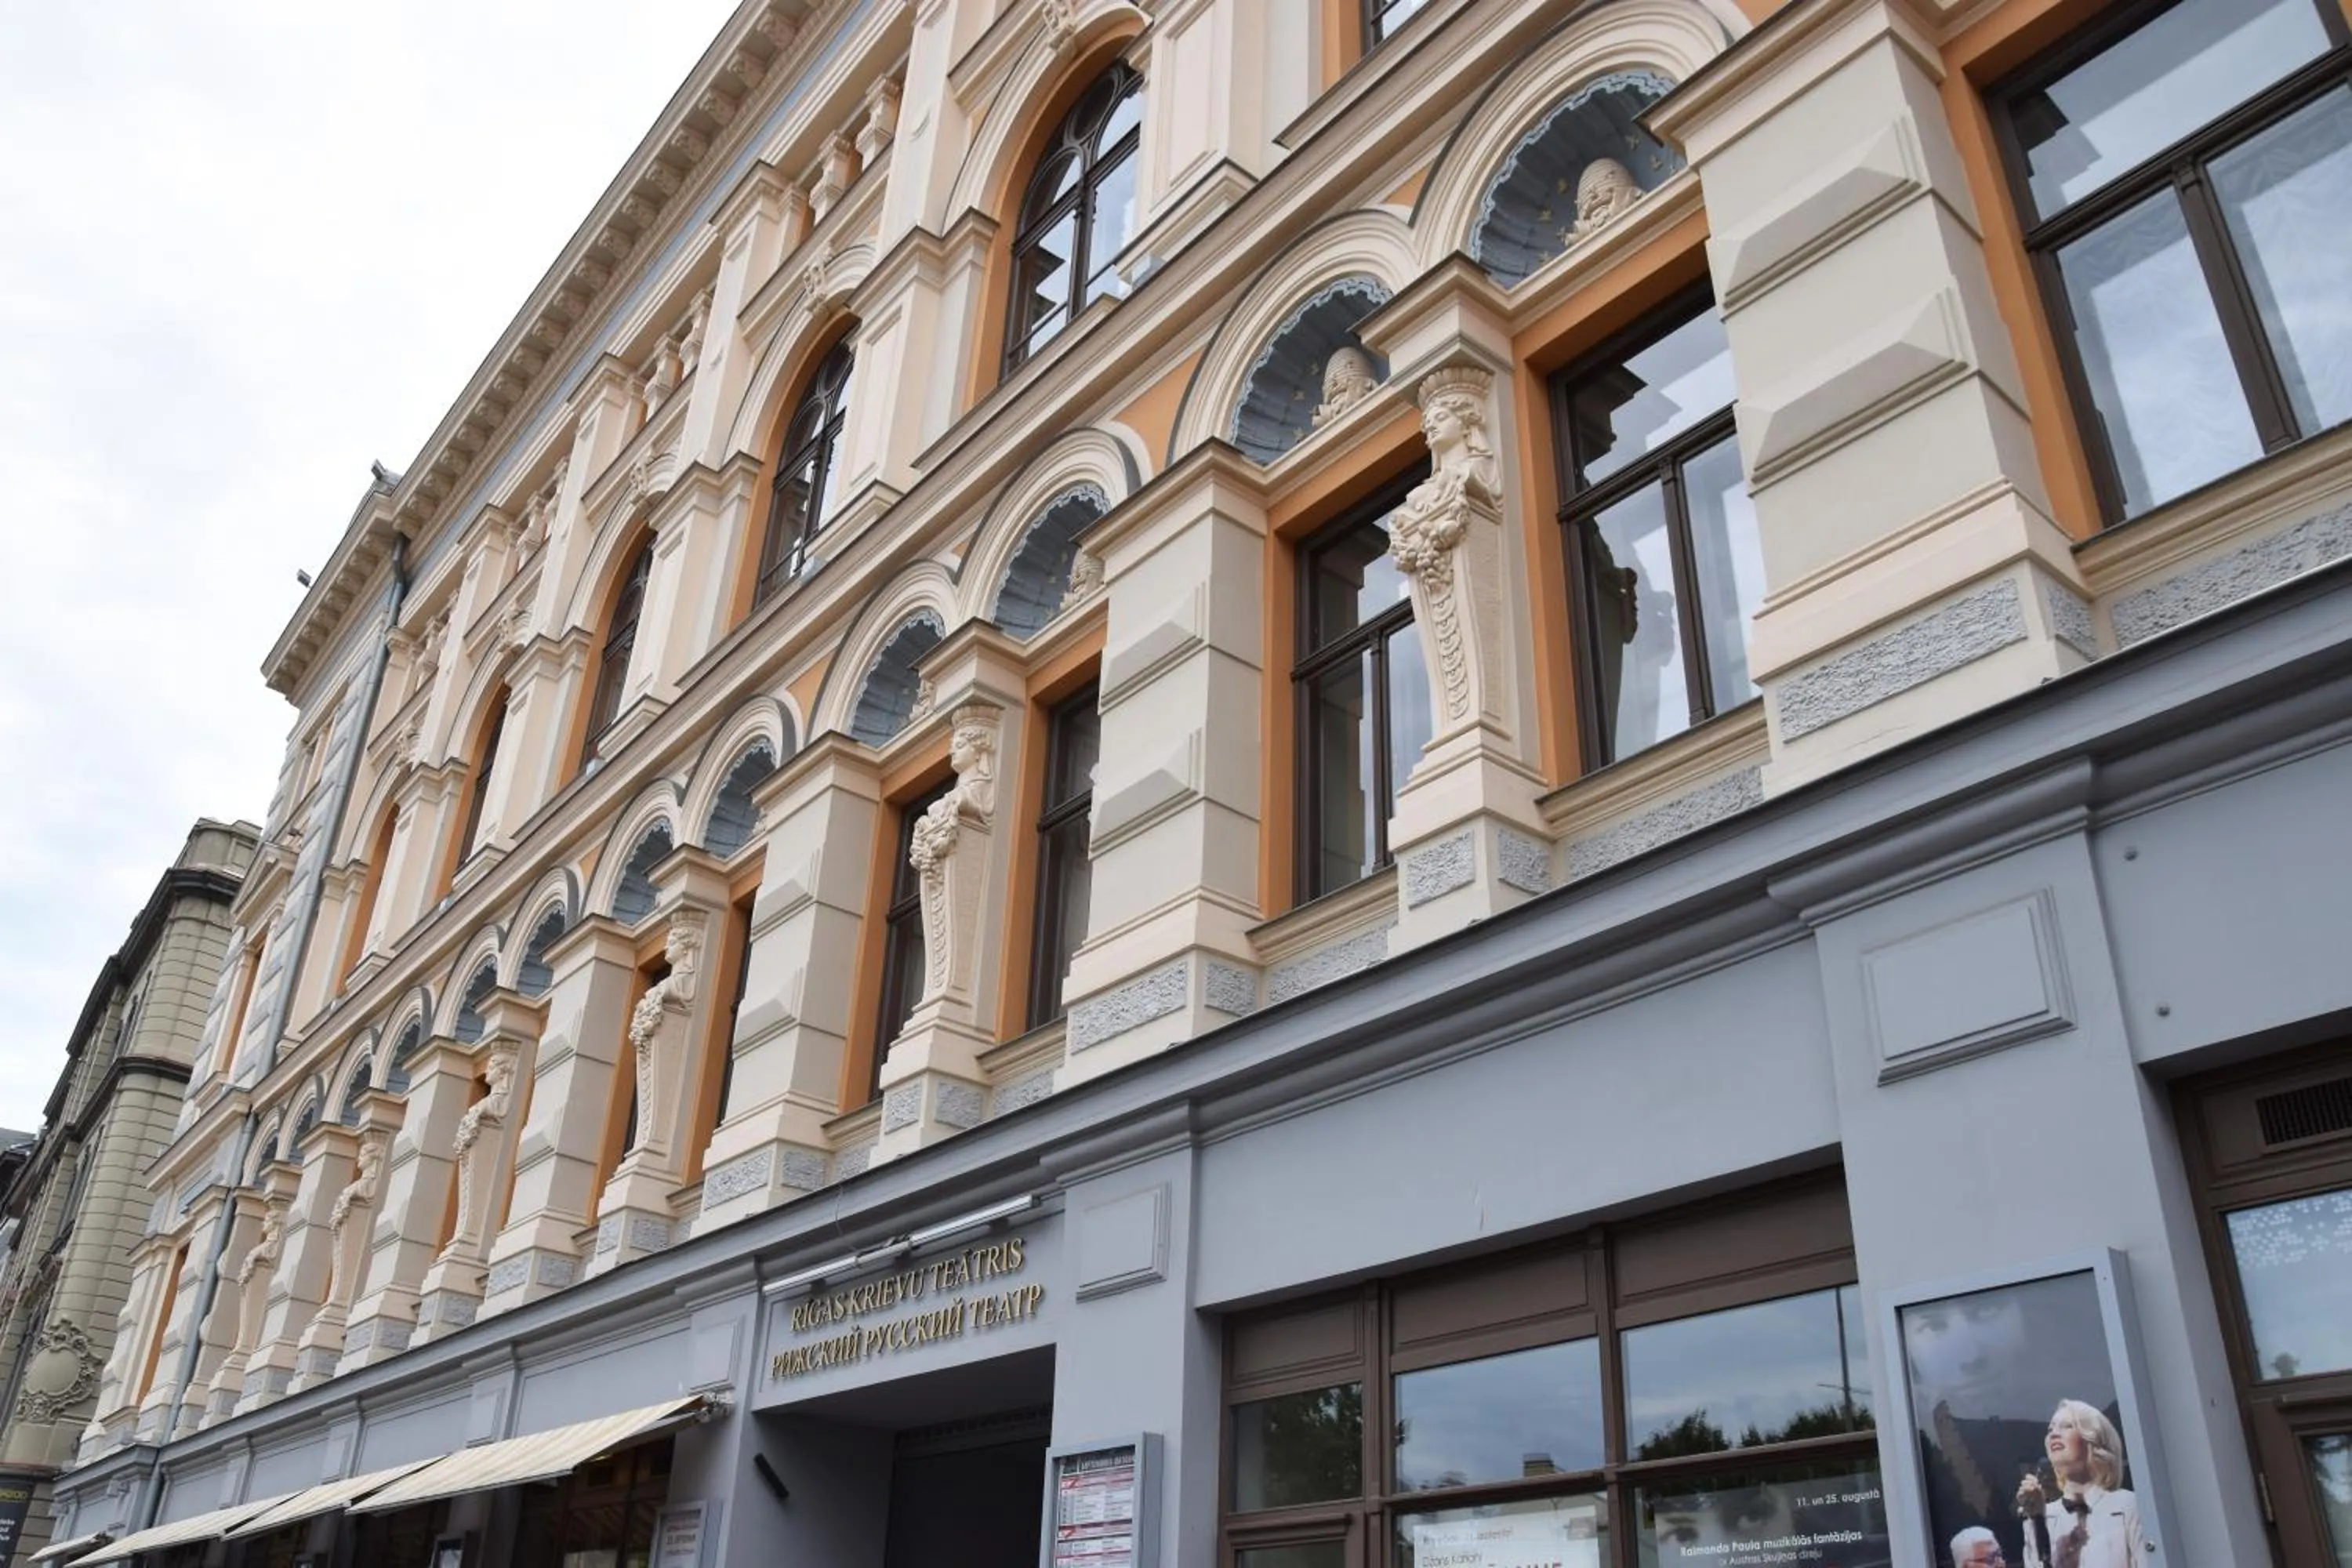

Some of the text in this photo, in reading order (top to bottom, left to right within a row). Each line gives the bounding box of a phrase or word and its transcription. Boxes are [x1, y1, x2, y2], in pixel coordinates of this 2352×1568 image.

[791, 1238, 1025, 1333] RĪGAS KRIEVU TEĀTRIS
[771, 1282, 1044, 1377] РИЖСКИЙ РУССКИЙ ТЕАТР
[1796, 1497, 1810, 1507] 11.
[1825, 1494, 1840, 1503] 25.
[1680, 1544, 1730, 1556] Raimonda
[1732, 1541, 1761, 1552] Paula
